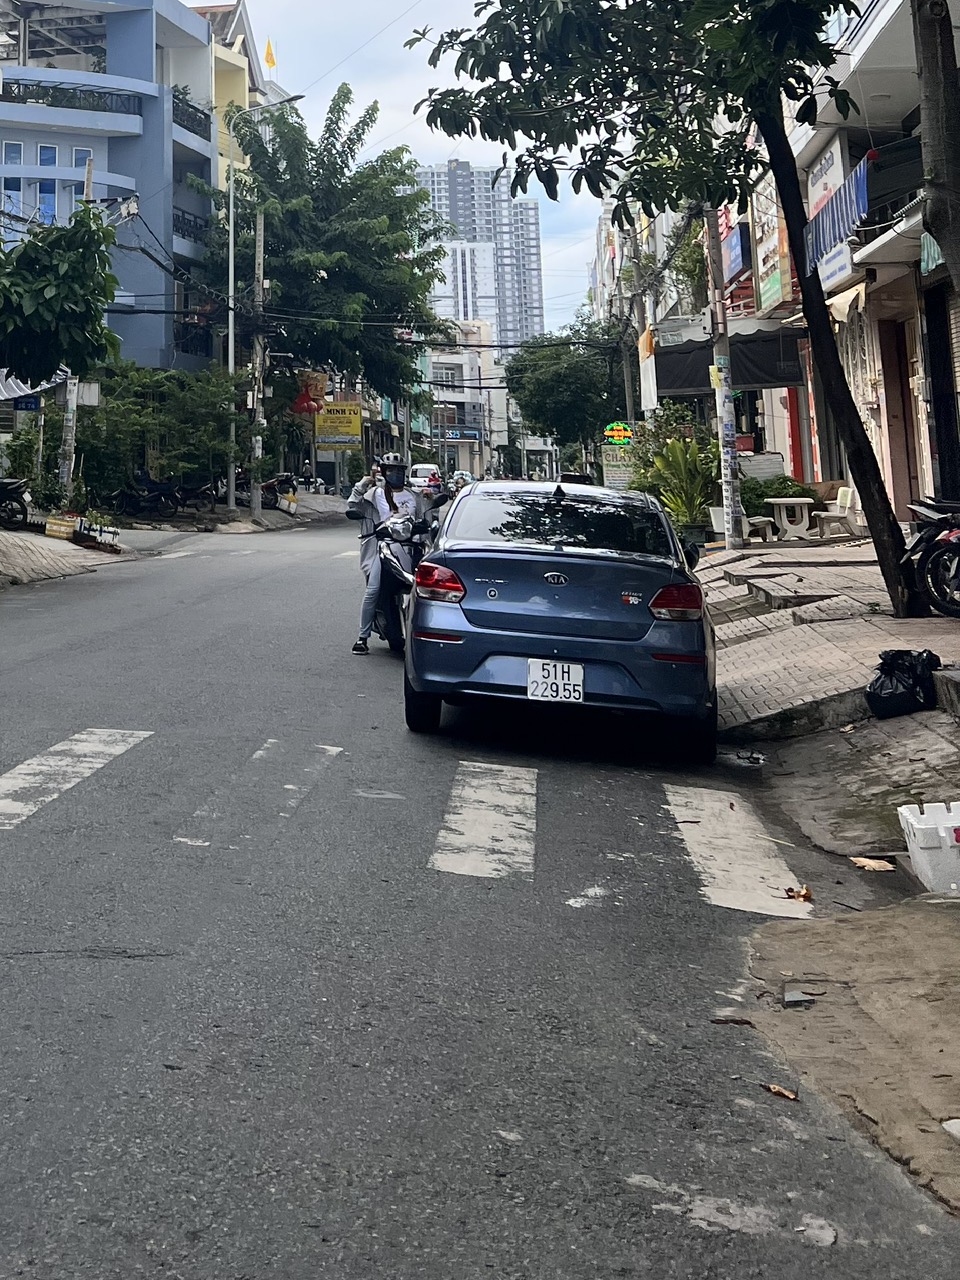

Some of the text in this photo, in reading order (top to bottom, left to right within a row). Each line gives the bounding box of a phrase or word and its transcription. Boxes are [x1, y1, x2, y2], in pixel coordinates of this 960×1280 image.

[547, 575, 565, 584] KIA
[541, 663, 571, 682] 51H
[530, 680, 582, 700] 229.55
